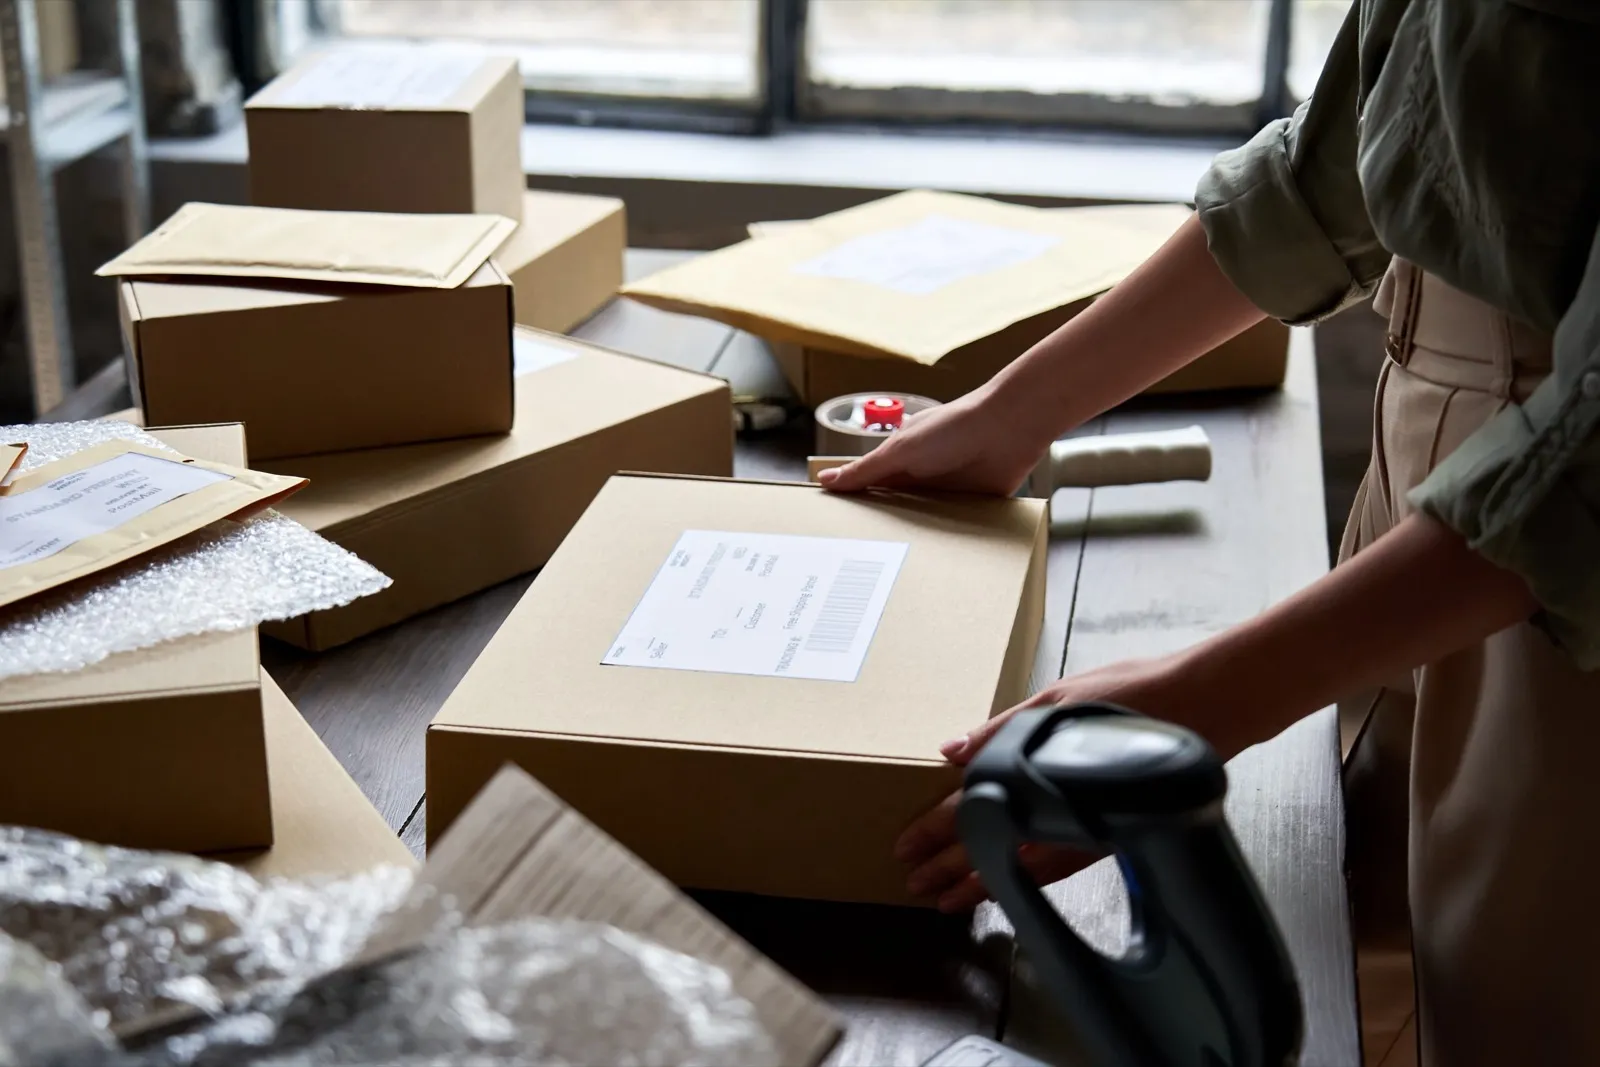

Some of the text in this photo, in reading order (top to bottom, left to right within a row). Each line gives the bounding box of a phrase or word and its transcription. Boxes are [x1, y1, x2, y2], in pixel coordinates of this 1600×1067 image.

[6, 492, 83, 523] STANDARD
[107, 487, 163, 514] PostMail
[743, 602, 766, 630] Customer
[782, 575, 819, 630] Free Shipping Parcel
[650, 642, 668, 659] Seller
[774, 641, 799, 673] TRACKING
